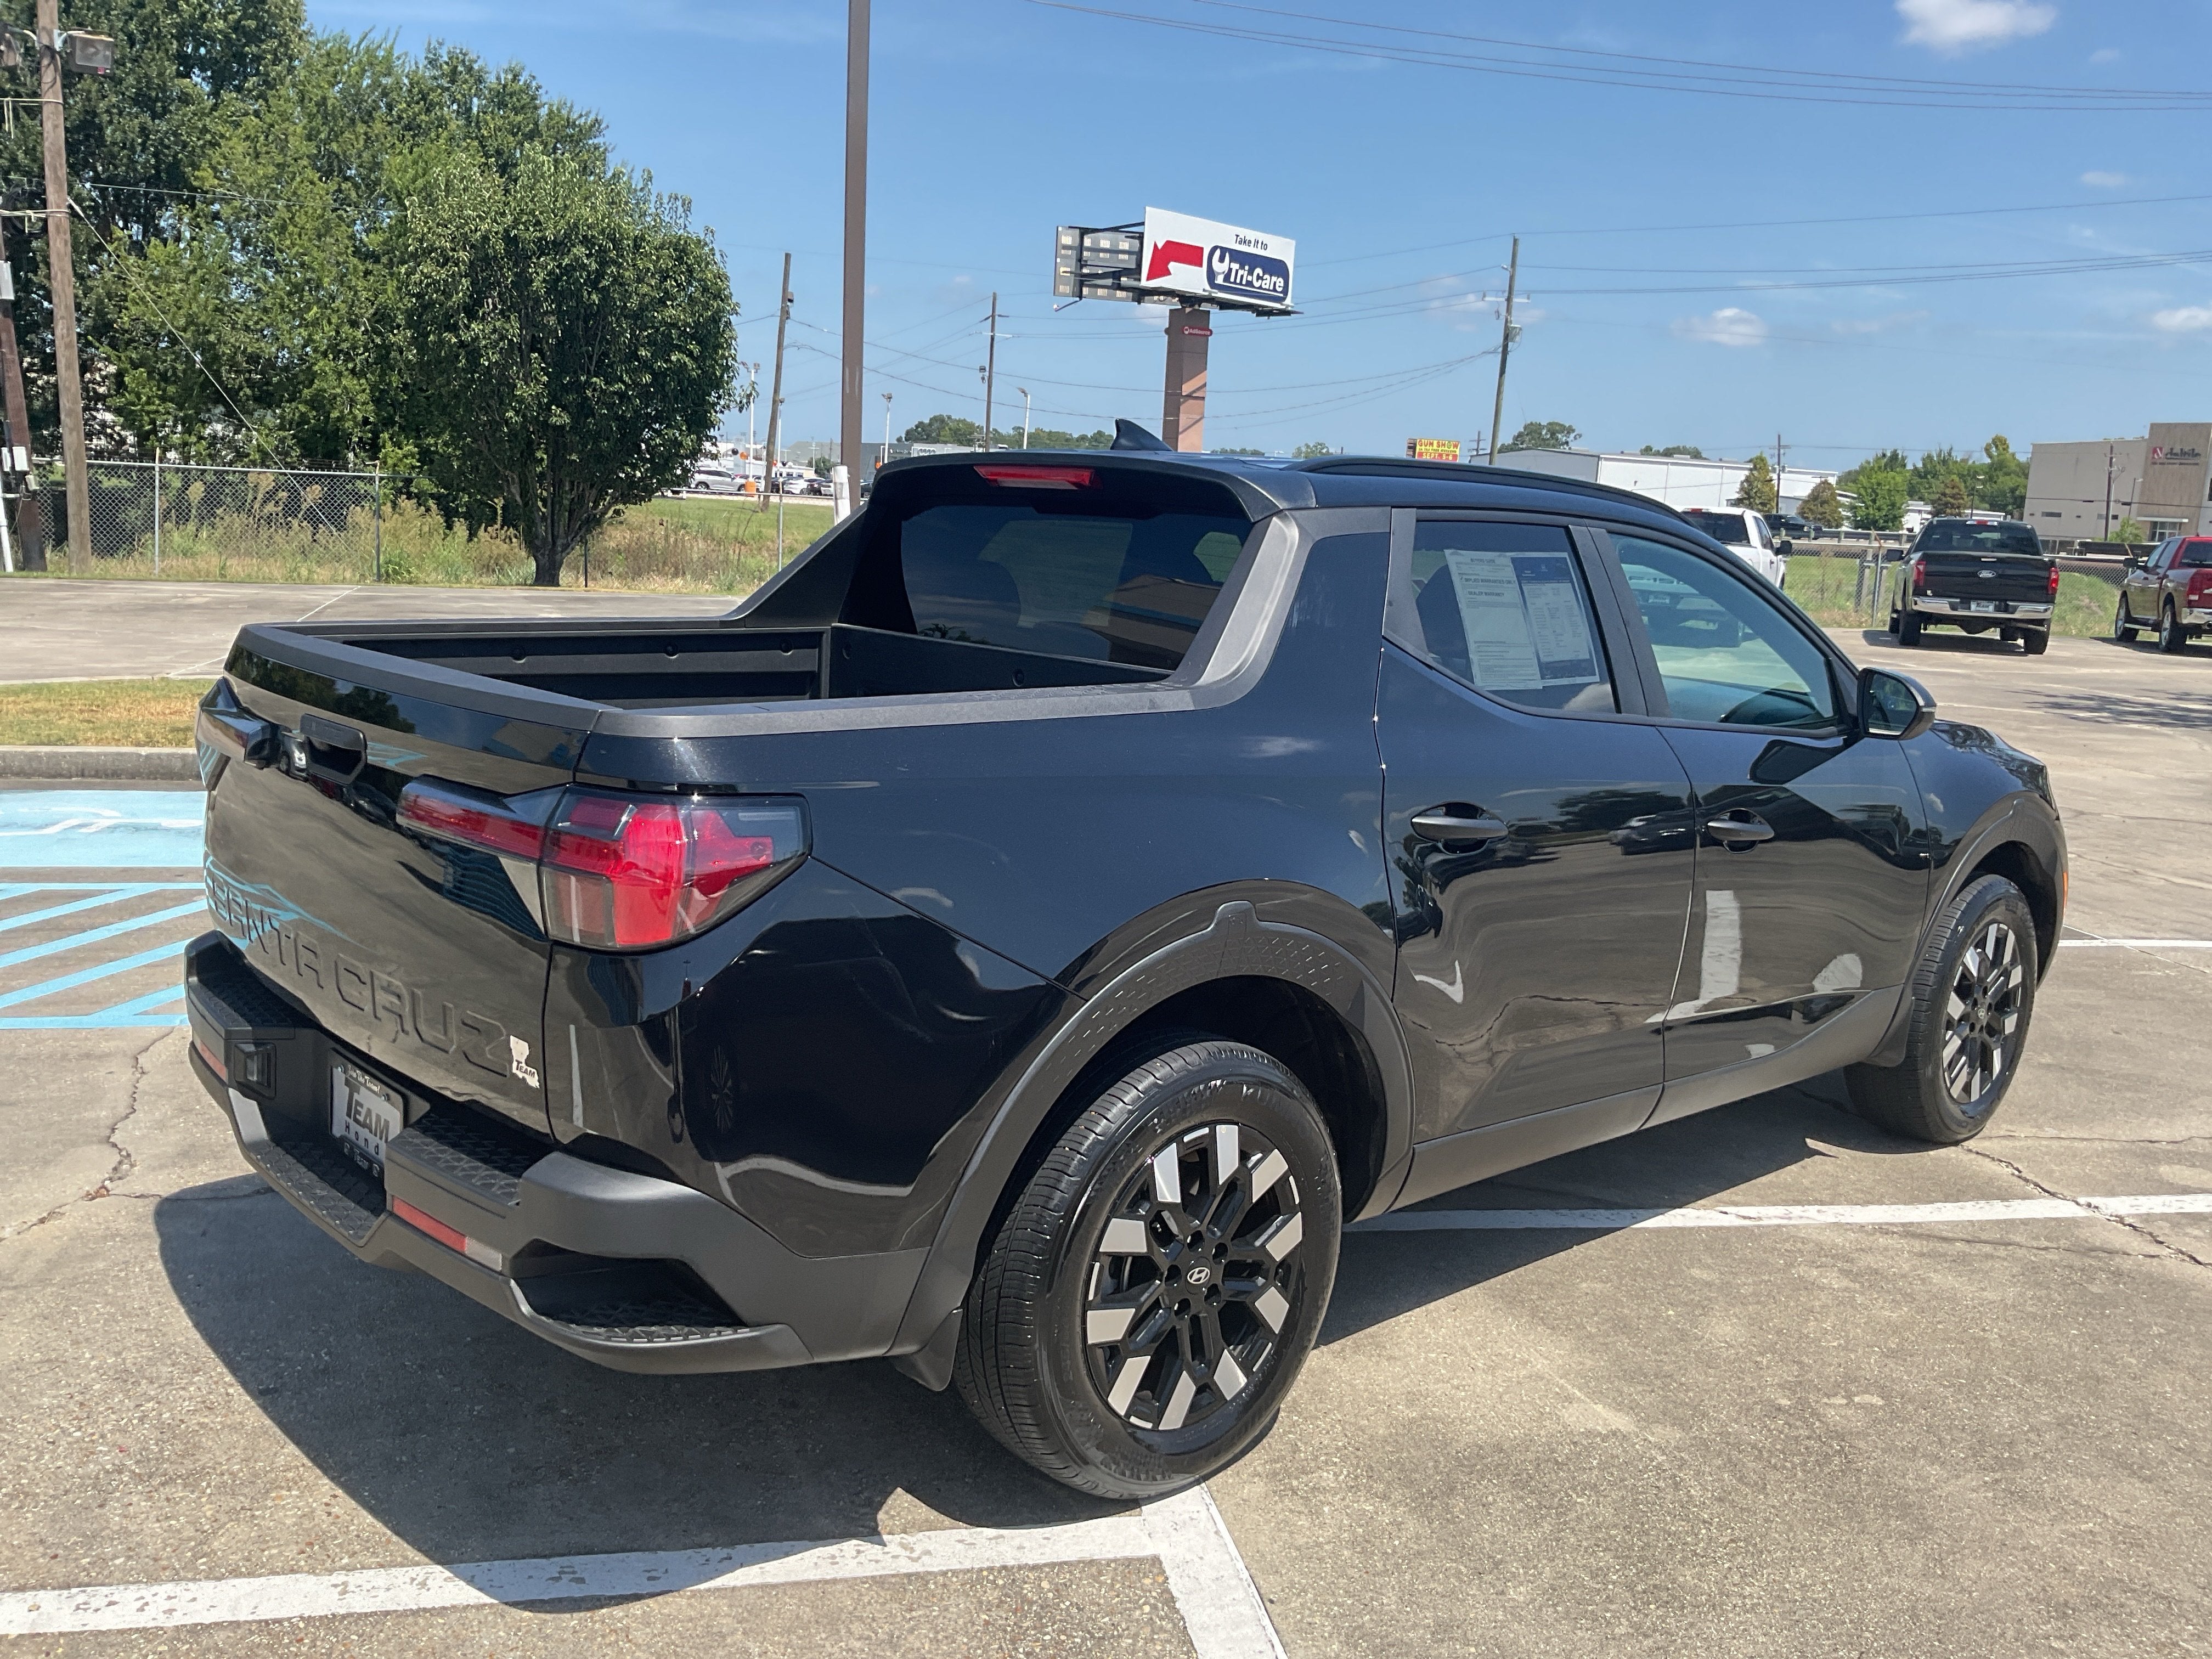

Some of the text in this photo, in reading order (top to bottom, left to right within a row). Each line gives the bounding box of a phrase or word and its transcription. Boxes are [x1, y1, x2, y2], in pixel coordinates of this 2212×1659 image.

[1235, 234, 1268, 250] Take It to
[1230, 263, 1284, 291] Tri-Care
[1436, 441, 1459, 449] SHOW
[211, 872, 324, 989] SANTA
[334, 953, 510, 1079] CRUZ
[515, 1059, 536, 1079] TEAM
[344, 1076, 390, 1144] TEAM
[345, 1119, 380, 1156] Hond
